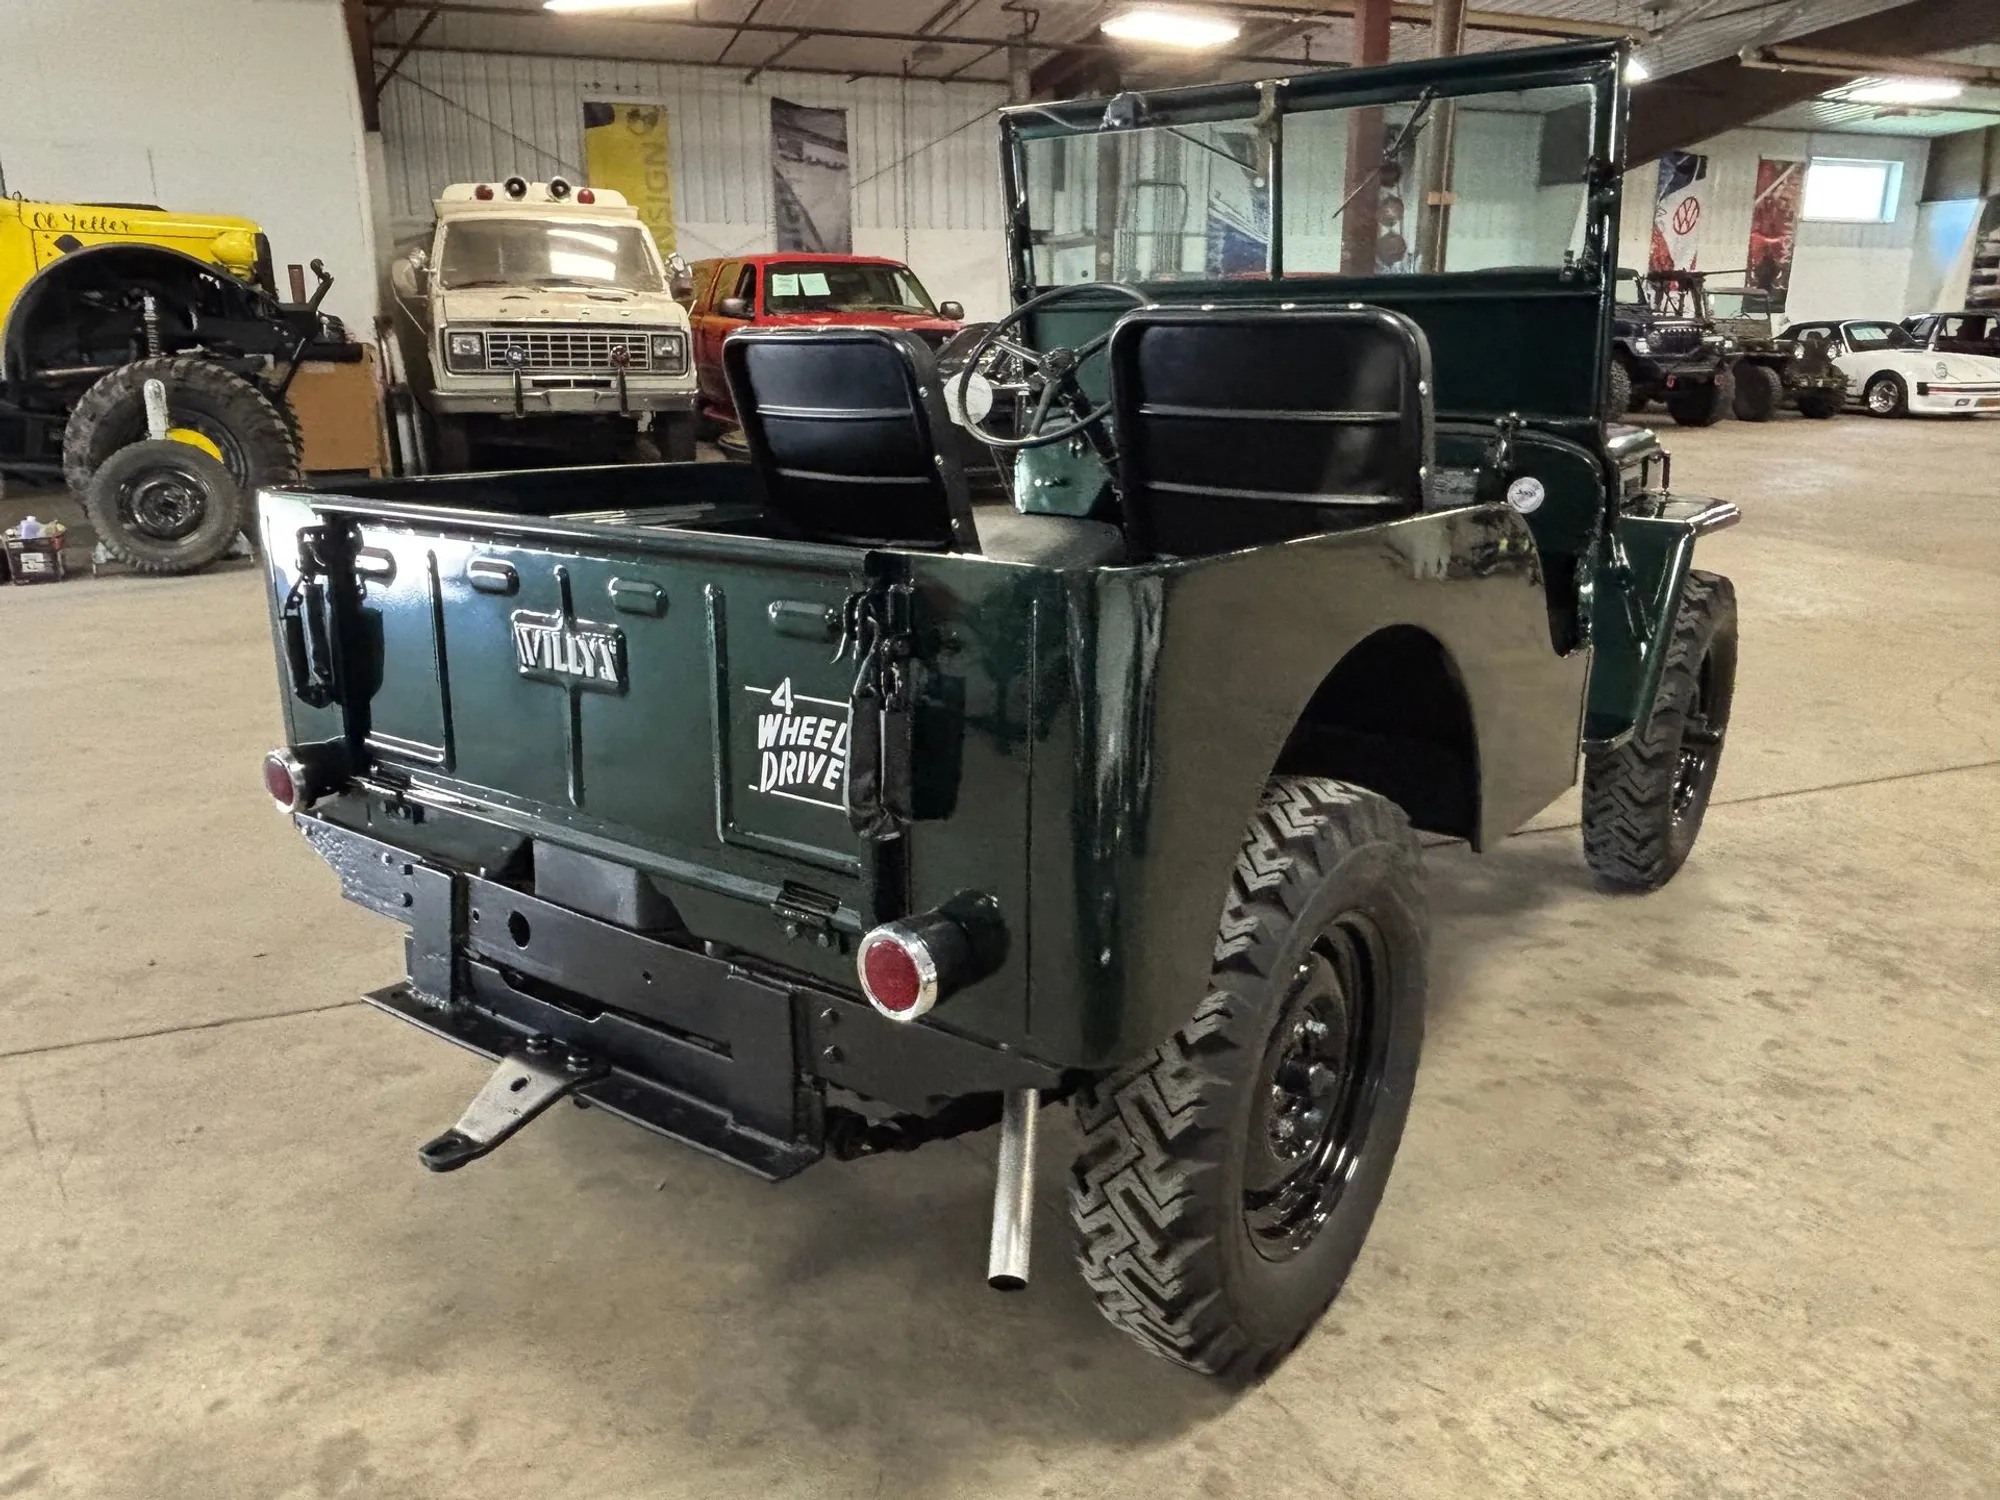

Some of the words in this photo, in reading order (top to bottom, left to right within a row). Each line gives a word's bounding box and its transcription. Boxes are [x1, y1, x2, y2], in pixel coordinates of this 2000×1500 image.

[514, 622, 619, 682] WILLYS
[770, 677, 794, 715] 4
[758, 713, 847, 757] WHEEL
[760, 750, 844, 793] DRIVE
